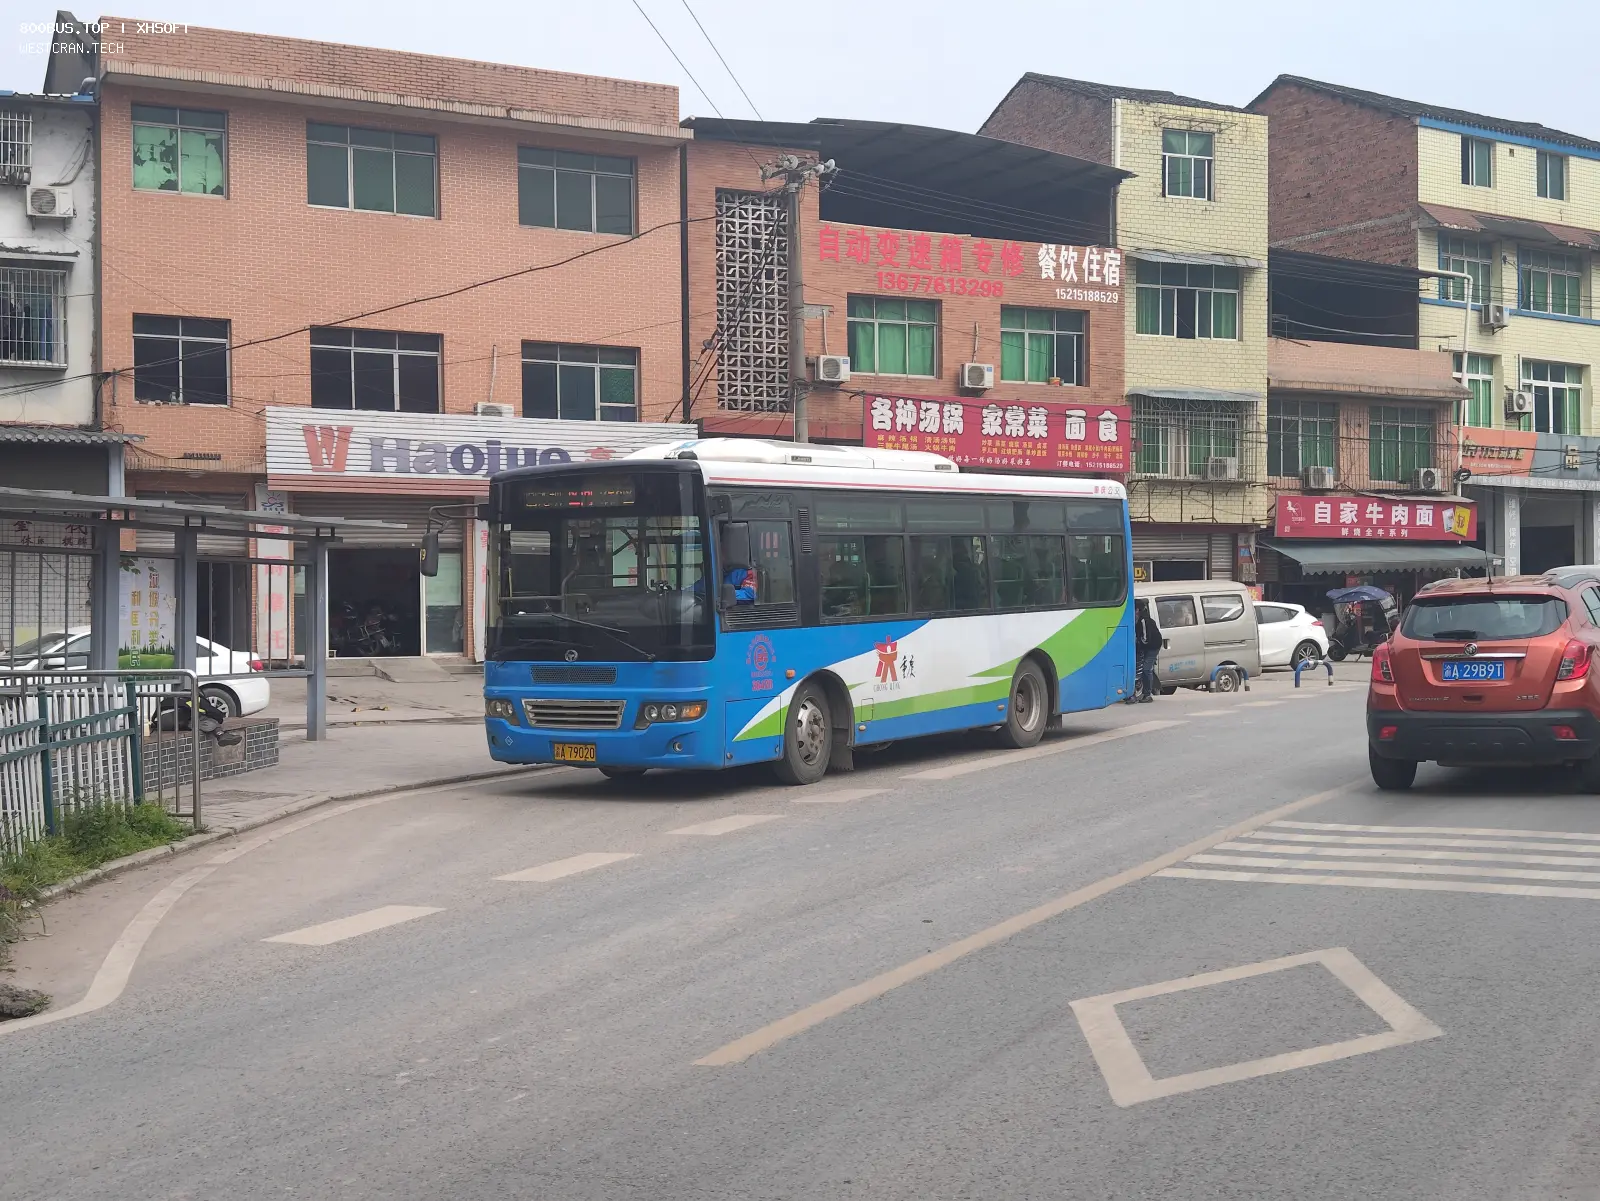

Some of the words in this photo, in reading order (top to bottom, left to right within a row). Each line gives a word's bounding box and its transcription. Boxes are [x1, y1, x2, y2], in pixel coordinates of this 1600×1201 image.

[818, 225, 1025, 278] 自动变速箱专修
[1038, 243, 1121, 286] 餐饮住宿
[876, 271, 1004, 298] 13677613298
[1055, 288, 1119, 304] 15215188529
[870, 397, 964, 435] 各种汤锅
[981, 403, 1048, 439] 家常菜
[369, 437, 572, 478] Haojue
[1314, 501, 1434, 527] 自家牛肉面
[1341, 527, 1408, 538] 鲜烧全牛系列
